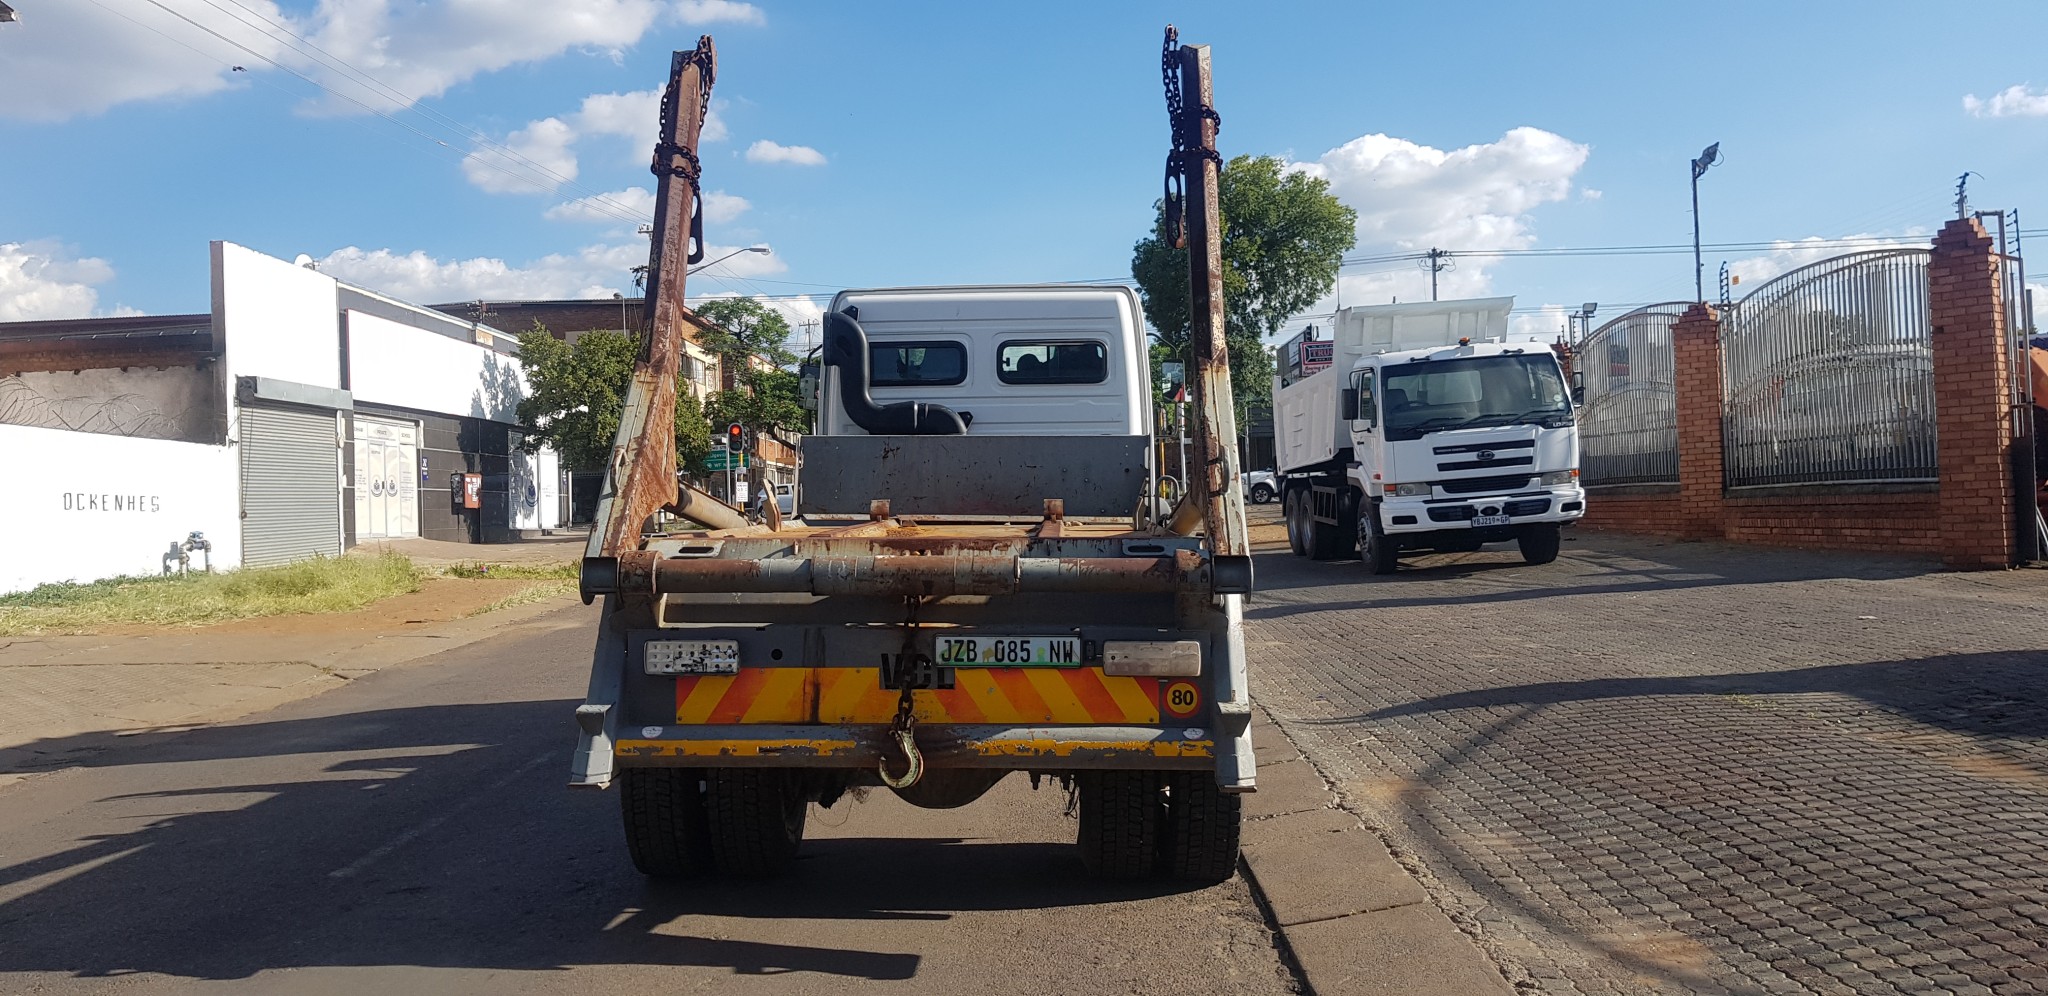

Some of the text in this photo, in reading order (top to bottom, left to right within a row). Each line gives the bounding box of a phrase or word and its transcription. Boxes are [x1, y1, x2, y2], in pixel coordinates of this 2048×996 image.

[941, 639, 1074, 662] JZB 085 NW
[1172, 689, 1194, 706] 80
